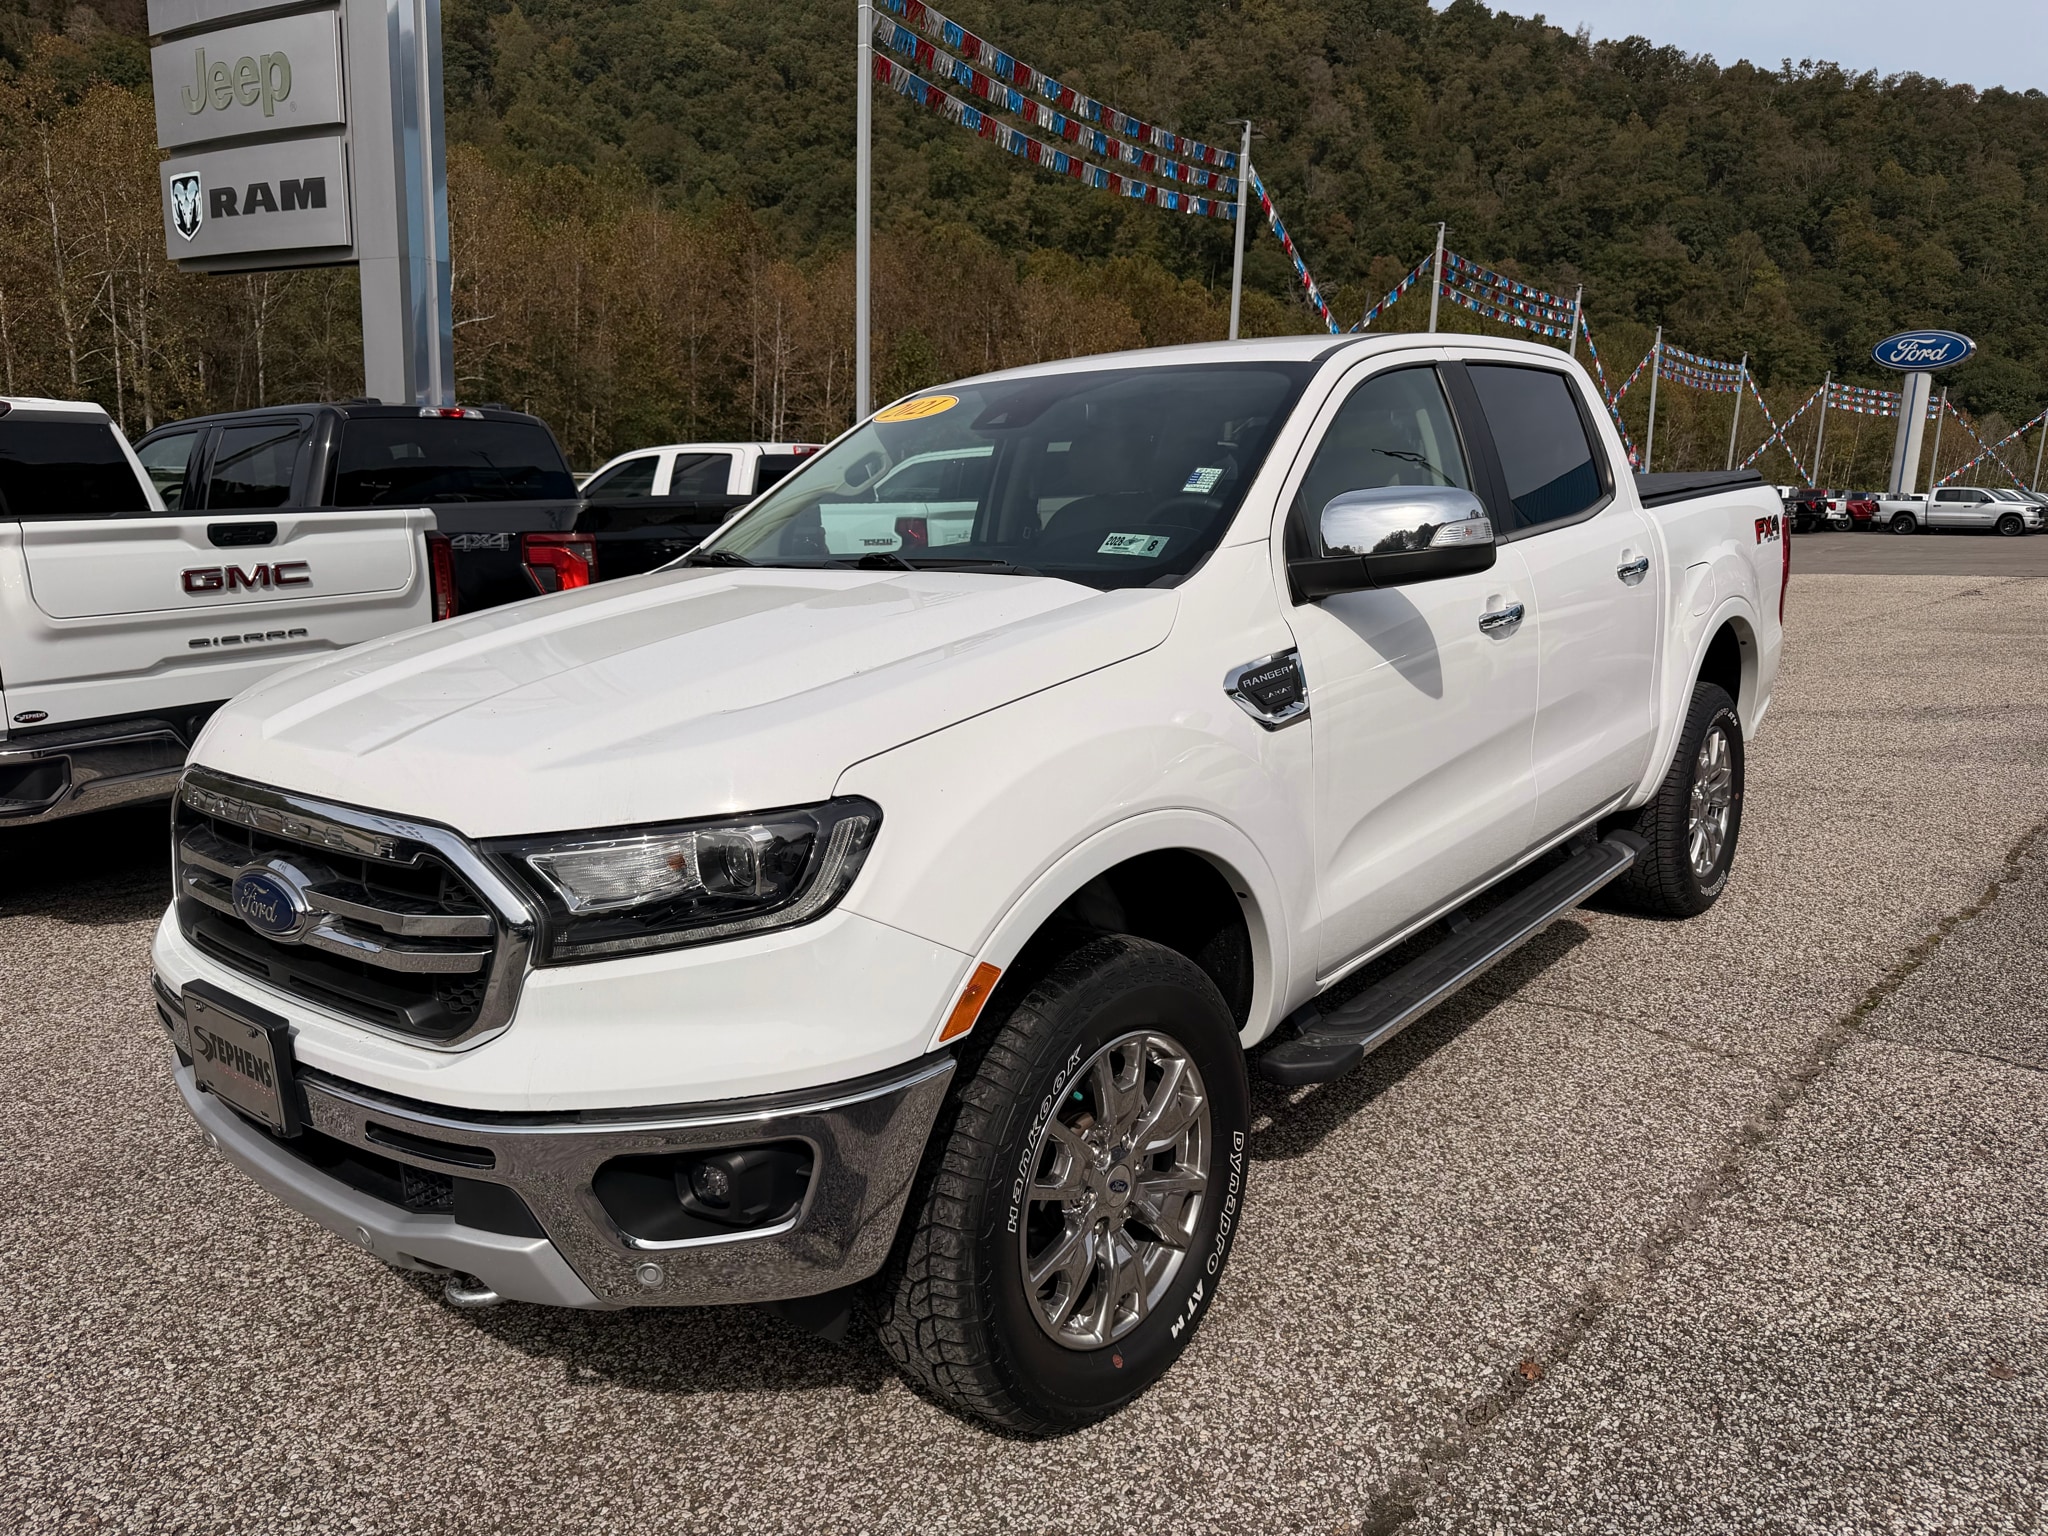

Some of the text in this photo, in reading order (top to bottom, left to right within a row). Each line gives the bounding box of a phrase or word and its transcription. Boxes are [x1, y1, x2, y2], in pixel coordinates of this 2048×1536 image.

[181, 47, 292, 117] Jeep
[209, 177, 327, 219] RAM
[1890, 339, 1951, 362] Ford
[880, 398, 951, 419] 2021
[1755, 514, 1780, 545] FX4
[1147, 540, 1159, 552] 8
[181, 560, 312, 594] GMC
[188, 628, 308, 649] SIERRA
[1242, 666, 1290, 688] RANGER
[240, 881, 278, 923] Ford
[193, 1025, 273, 1088] STEPHENS
